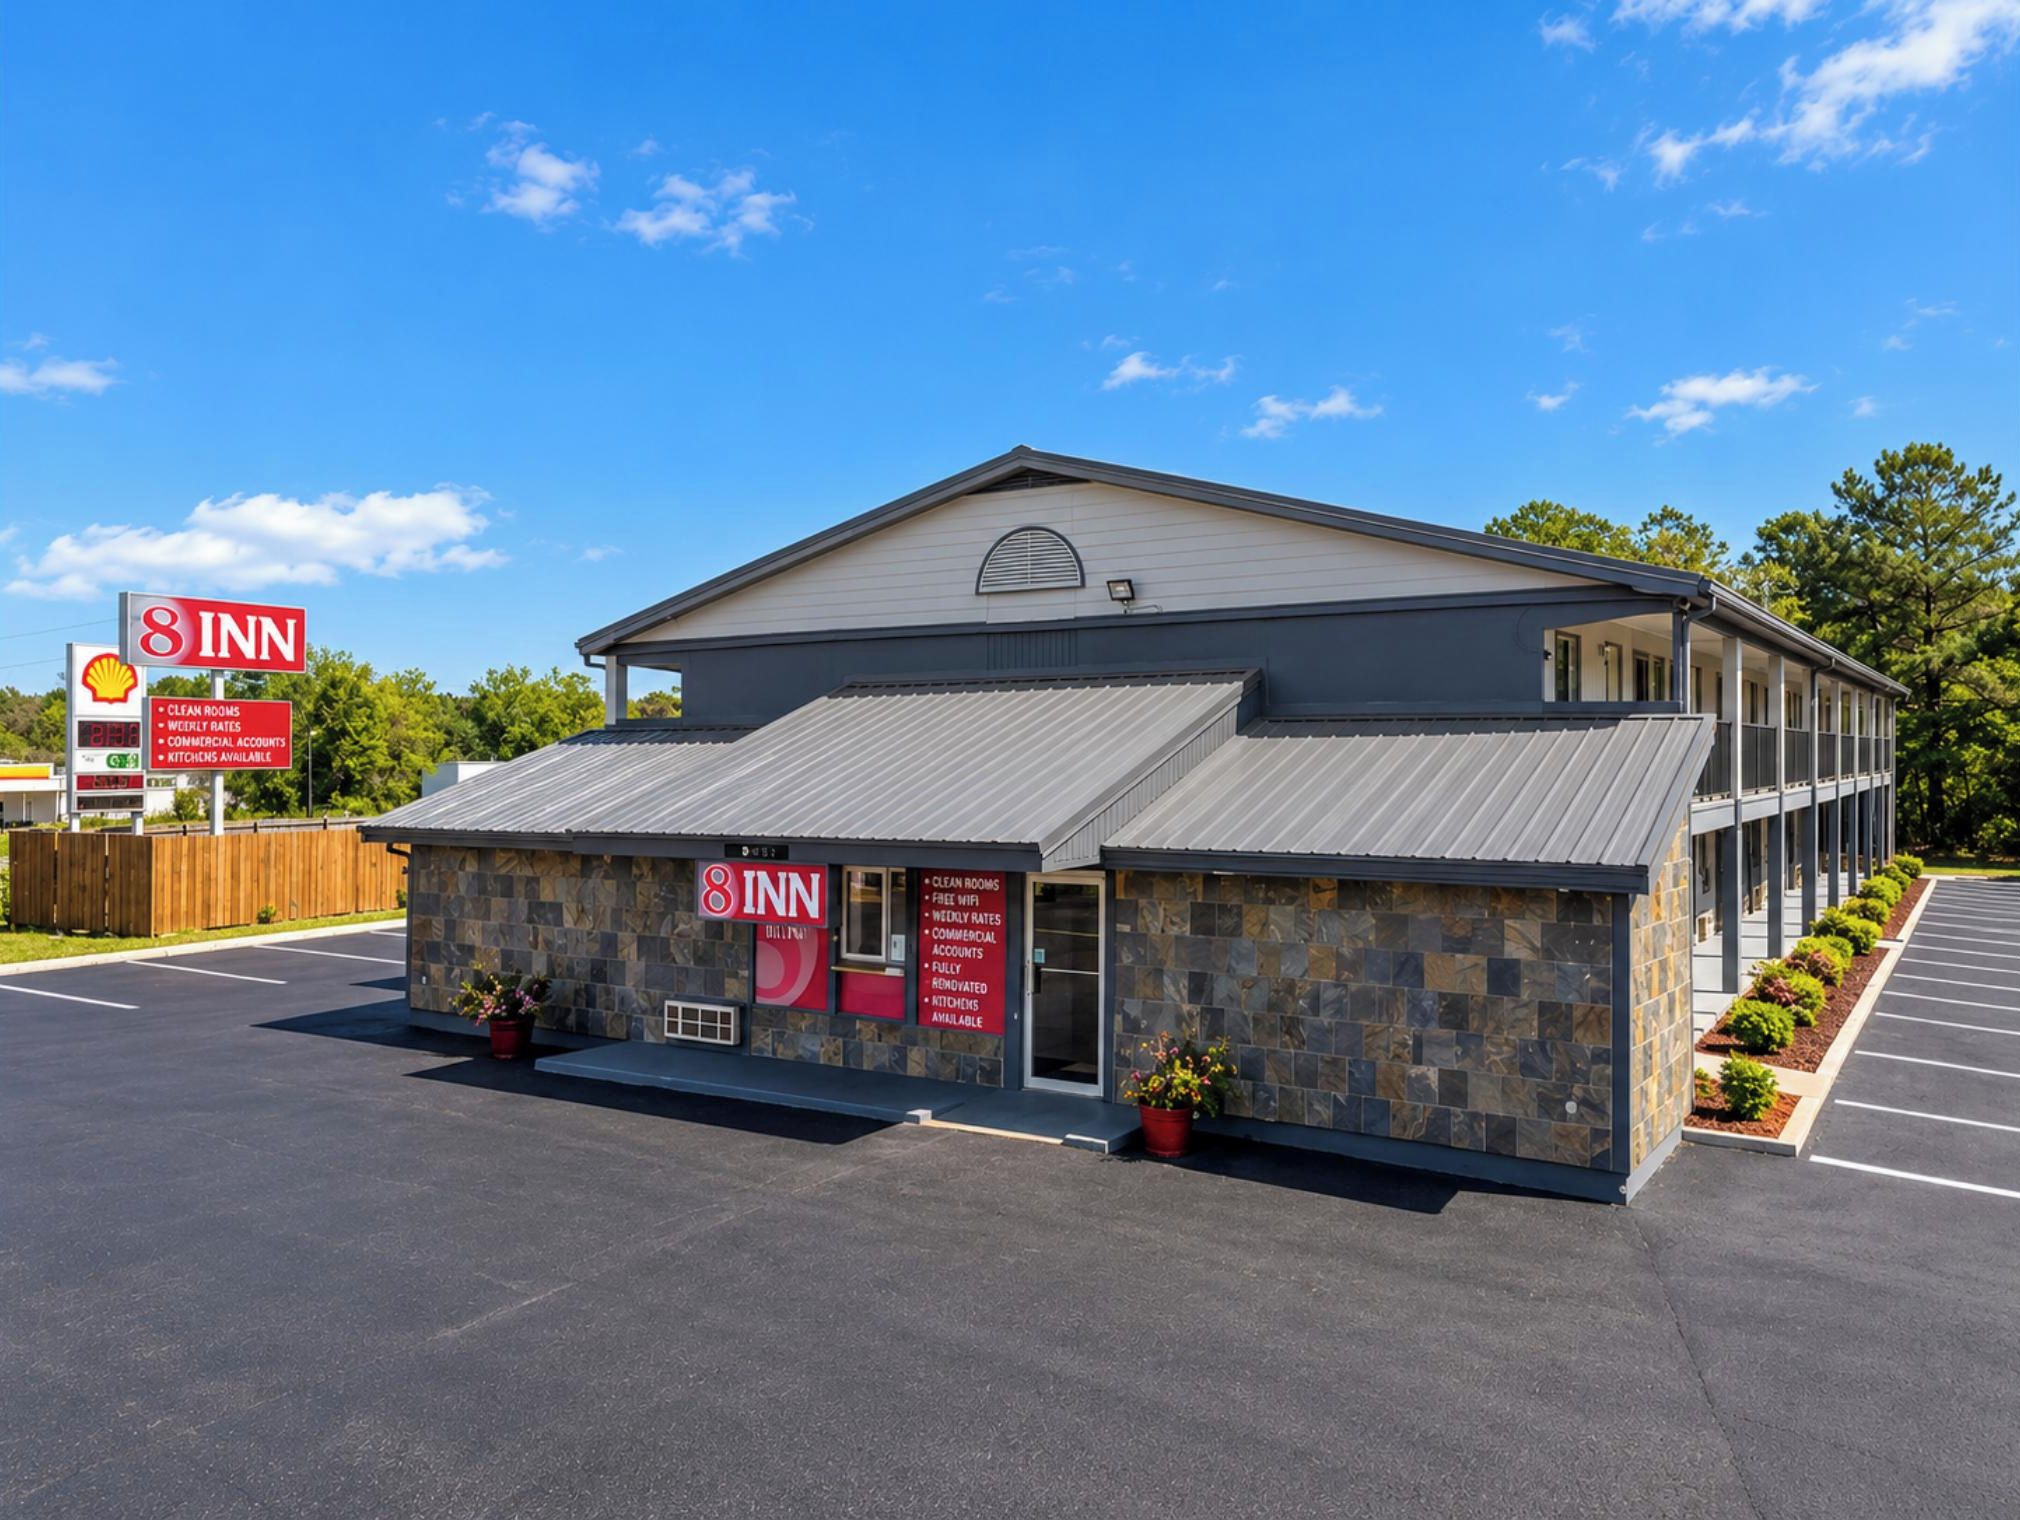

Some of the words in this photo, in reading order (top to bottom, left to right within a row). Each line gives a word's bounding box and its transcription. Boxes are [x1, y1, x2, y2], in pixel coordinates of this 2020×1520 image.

[138, 604, 185, 659] 8
[199, 610, 297, 662] INN
[167, 704, 202, 716] CLEAN
[204, 705, 240, 717] ROOMS
[210, 721, 241, 733] RATES
[167, 736, 234, 747] COMMERCIAL
[237, 737, 286, 748] ACCOUNTS
[167, 751, 218, 763] KITCHENS
[220, 752, 272, 763] AVAILABLE
[702, 864, 734, 917] 8
[743, 870, 821, 919] INN
[932, 876, 962, 889] CLEAN
[964, 878, 1000, 891] ROOMS
[971, 912, 1001, 926] RATES
[932, 927, 997, 944] COMMERCIAL
[932, 943, 984, 960] ACCOUNTS
[932, 961, 961, 975] FULLY
[932, 977, 988, 995] RENOVATED
[932, 995, 979, 1012] KITCHENS
[932, 1011, 983, 1028] AVAILABLE
